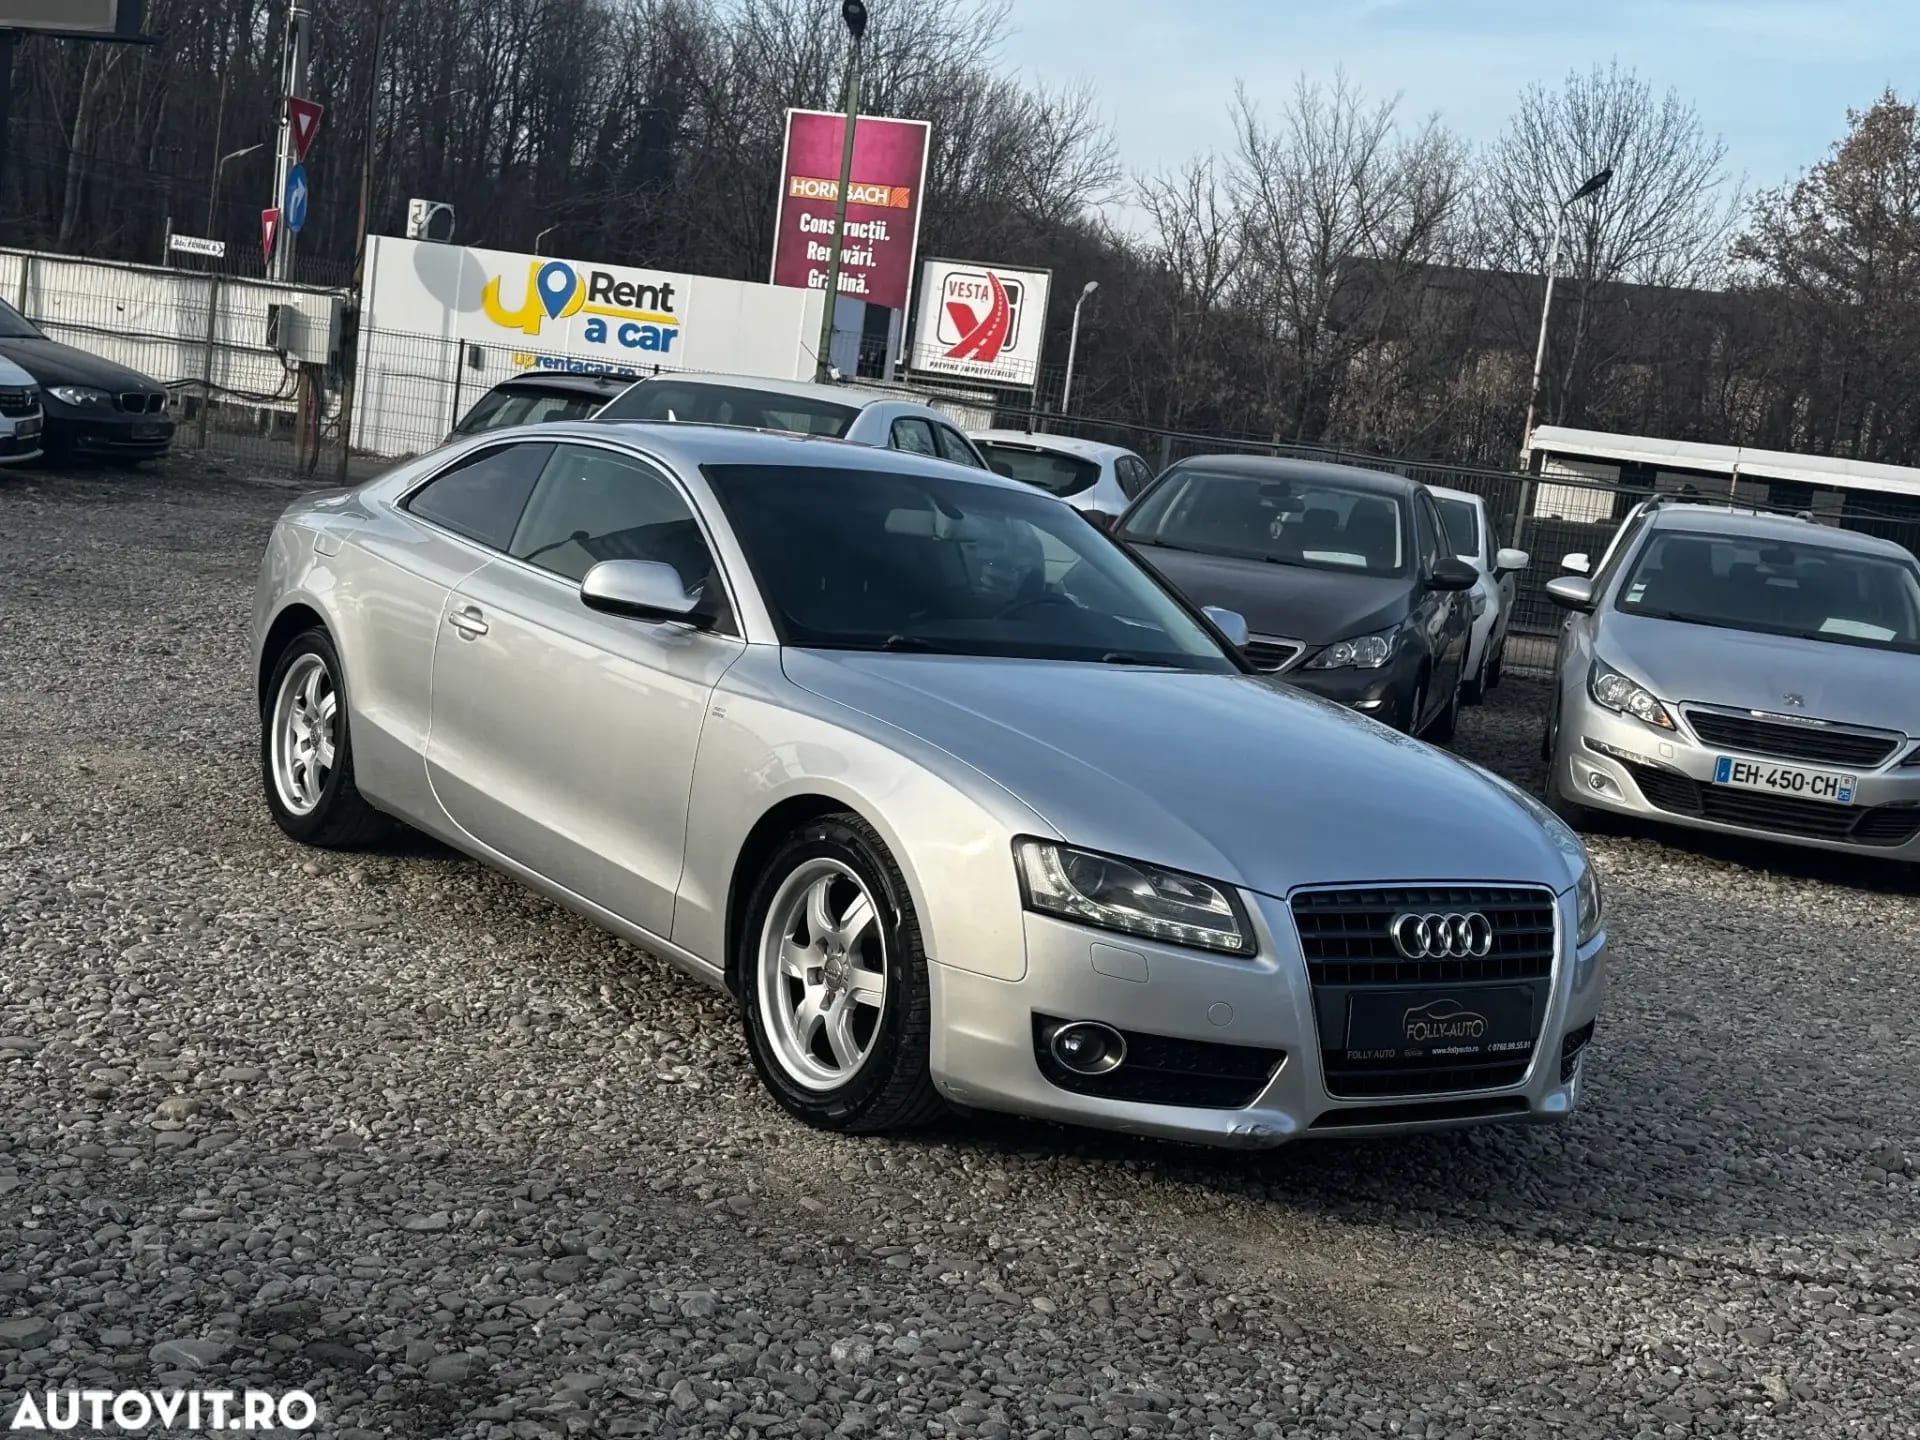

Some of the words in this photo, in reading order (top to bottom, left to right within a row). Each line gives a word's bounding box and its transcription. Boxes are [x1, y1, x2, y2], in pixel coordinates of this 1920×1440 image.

[800, 213, 890, 245] Consrucții.
[588, 271, 675, 313] Rent
[949, 280, 989, 301] VESTA
[584, 317, 608, 344] a
[618, 322, 679, 353] car
[511, 351, 637, 377] uprentacarro
[1732, 762, 1838, 797] EH-450-CH
[1839, 790, 1850, 800] 25
[1347, 1050, 1373, 1060] FOLLY
[1373, 1049, 1396, 1059] AUTO
